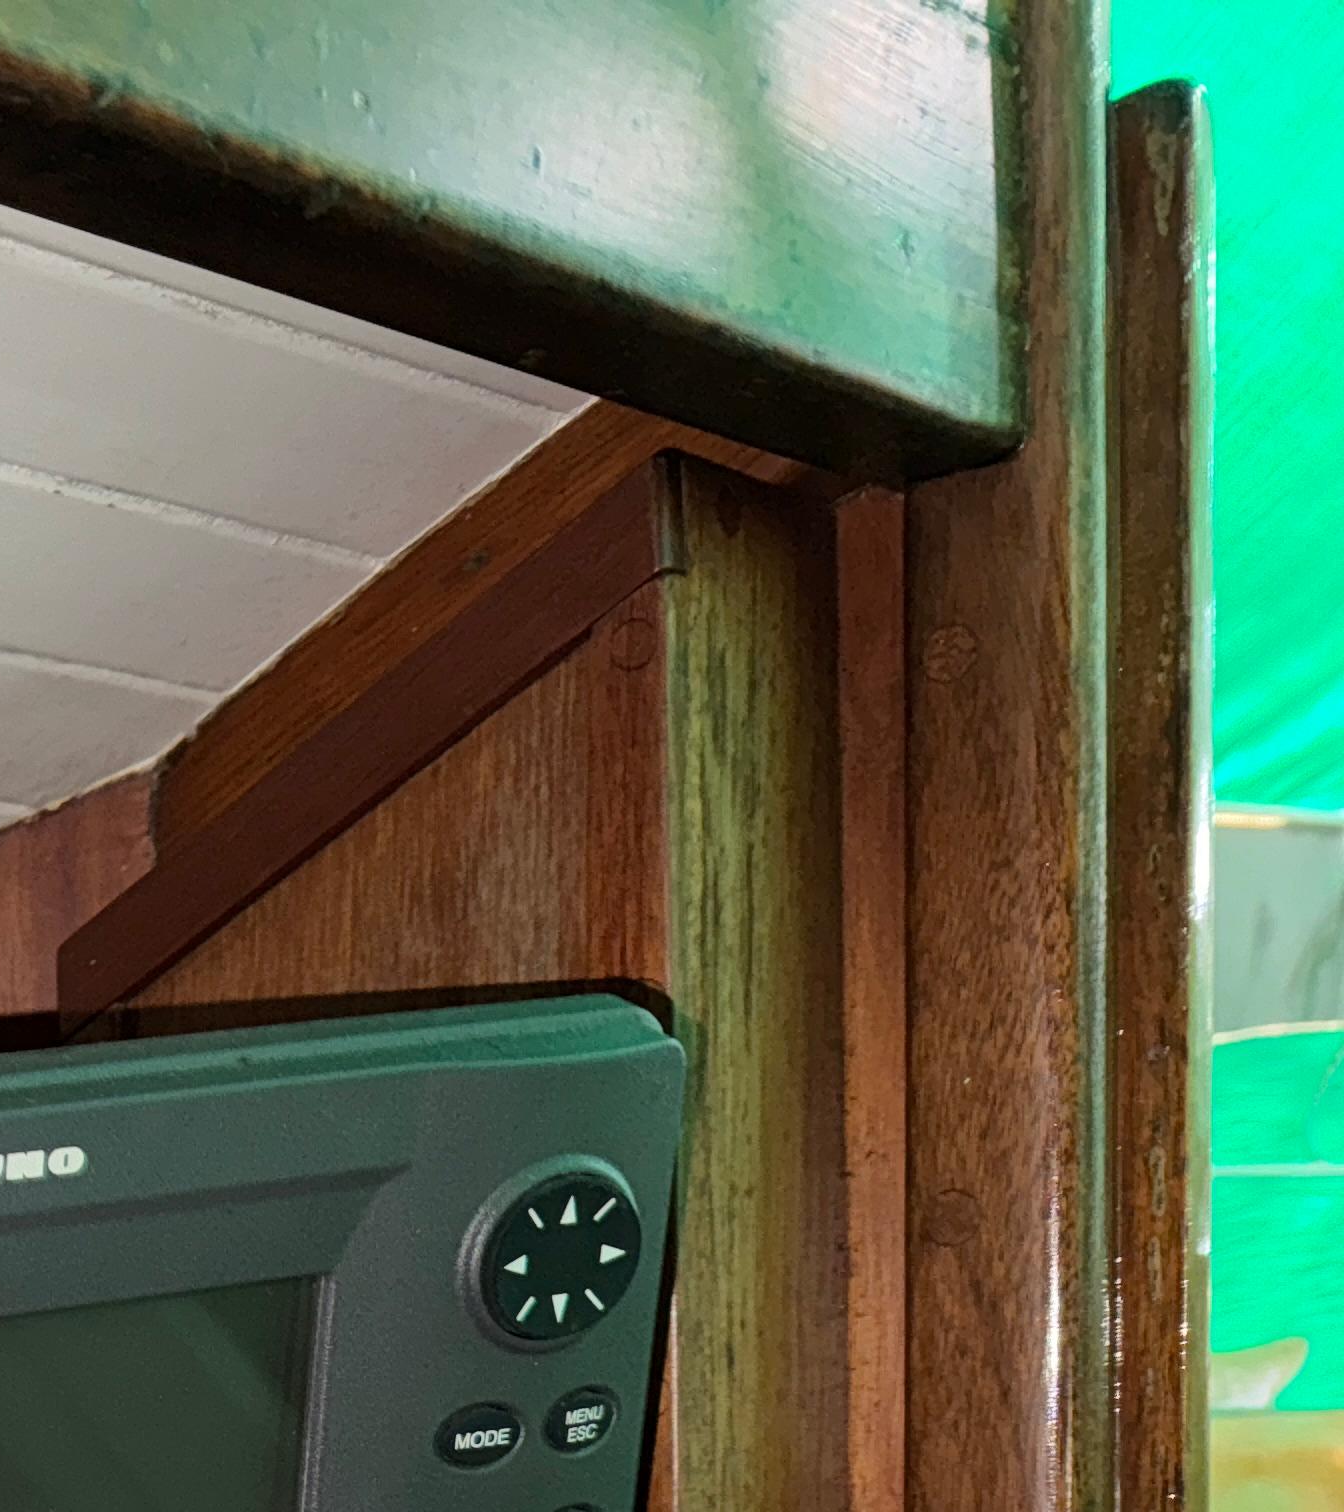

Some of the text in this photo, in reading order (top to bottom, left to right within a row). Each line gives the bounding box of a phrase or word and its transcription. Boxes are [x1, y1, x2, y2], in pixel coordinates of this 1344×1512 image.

[565, 1405, 604, 1425] MENU
[454, 1427, 512, 1450] MODE
[567, 1424, 597, 1443] ESC
